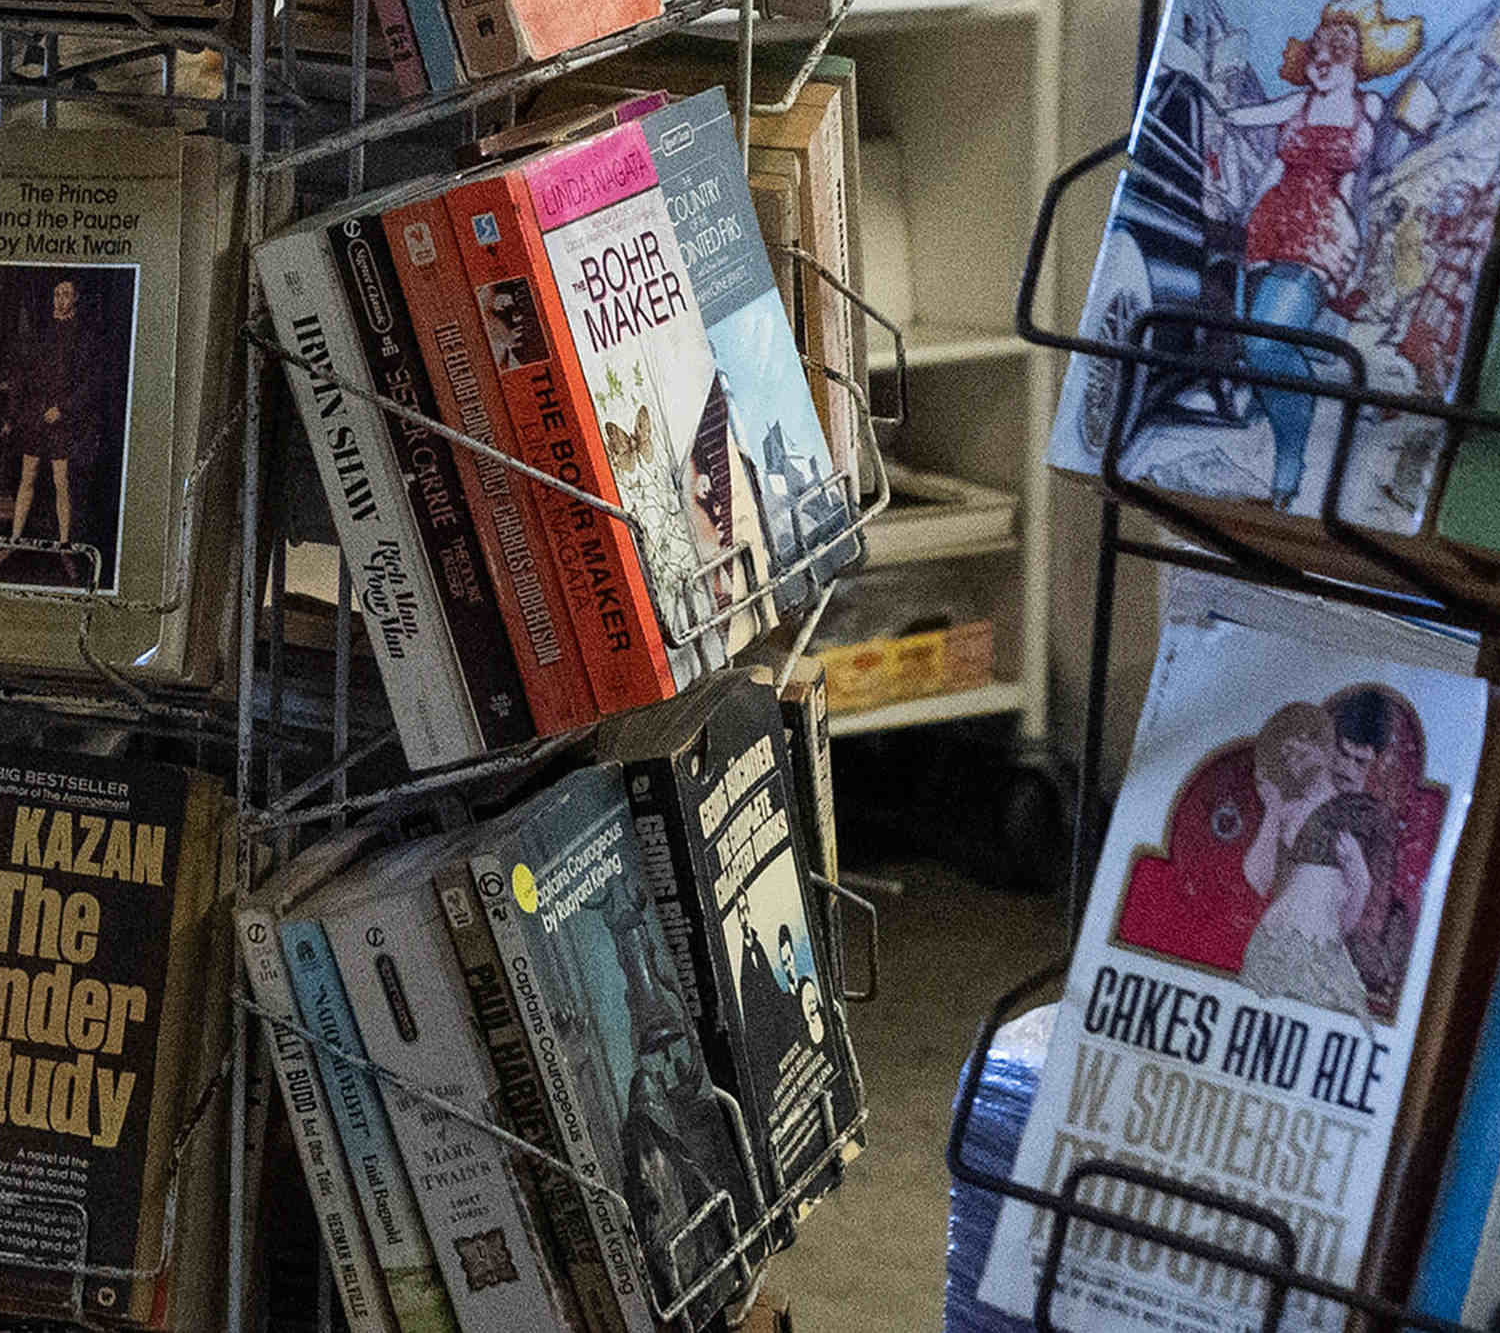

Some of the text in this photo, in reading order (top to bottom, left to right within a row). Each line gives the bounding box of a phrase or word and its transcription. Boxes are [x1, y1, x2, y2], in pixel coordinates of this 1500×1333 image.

[19, 183, 118, 205] The Prince
[36, 208, 70, 230] the
[71, 210, 141, 235] Pauper
[23, 235, 75, 255] Mark
[80, 236, 133, 256] Twain
[350, 246, 388, 327] Signet Classic
[583, 271, 688, 354] MAKER
[291, 312, 381, 529] IRWIN SHAW
[528, 367, 634, 654] THE BOHR MAKER
[24, 770, 129, 797] BESTSELLER
[10, 805, 167, 886] KAZAN
[1083, 965, 1391, 1117] CAKES AND ALE
[16, 1147, 89, 1168] A novel of the
[422, 1143, 476, 1167] MARK
[47, 1167, 68, 1179] and
[70, 1171, 88, 1183] the
